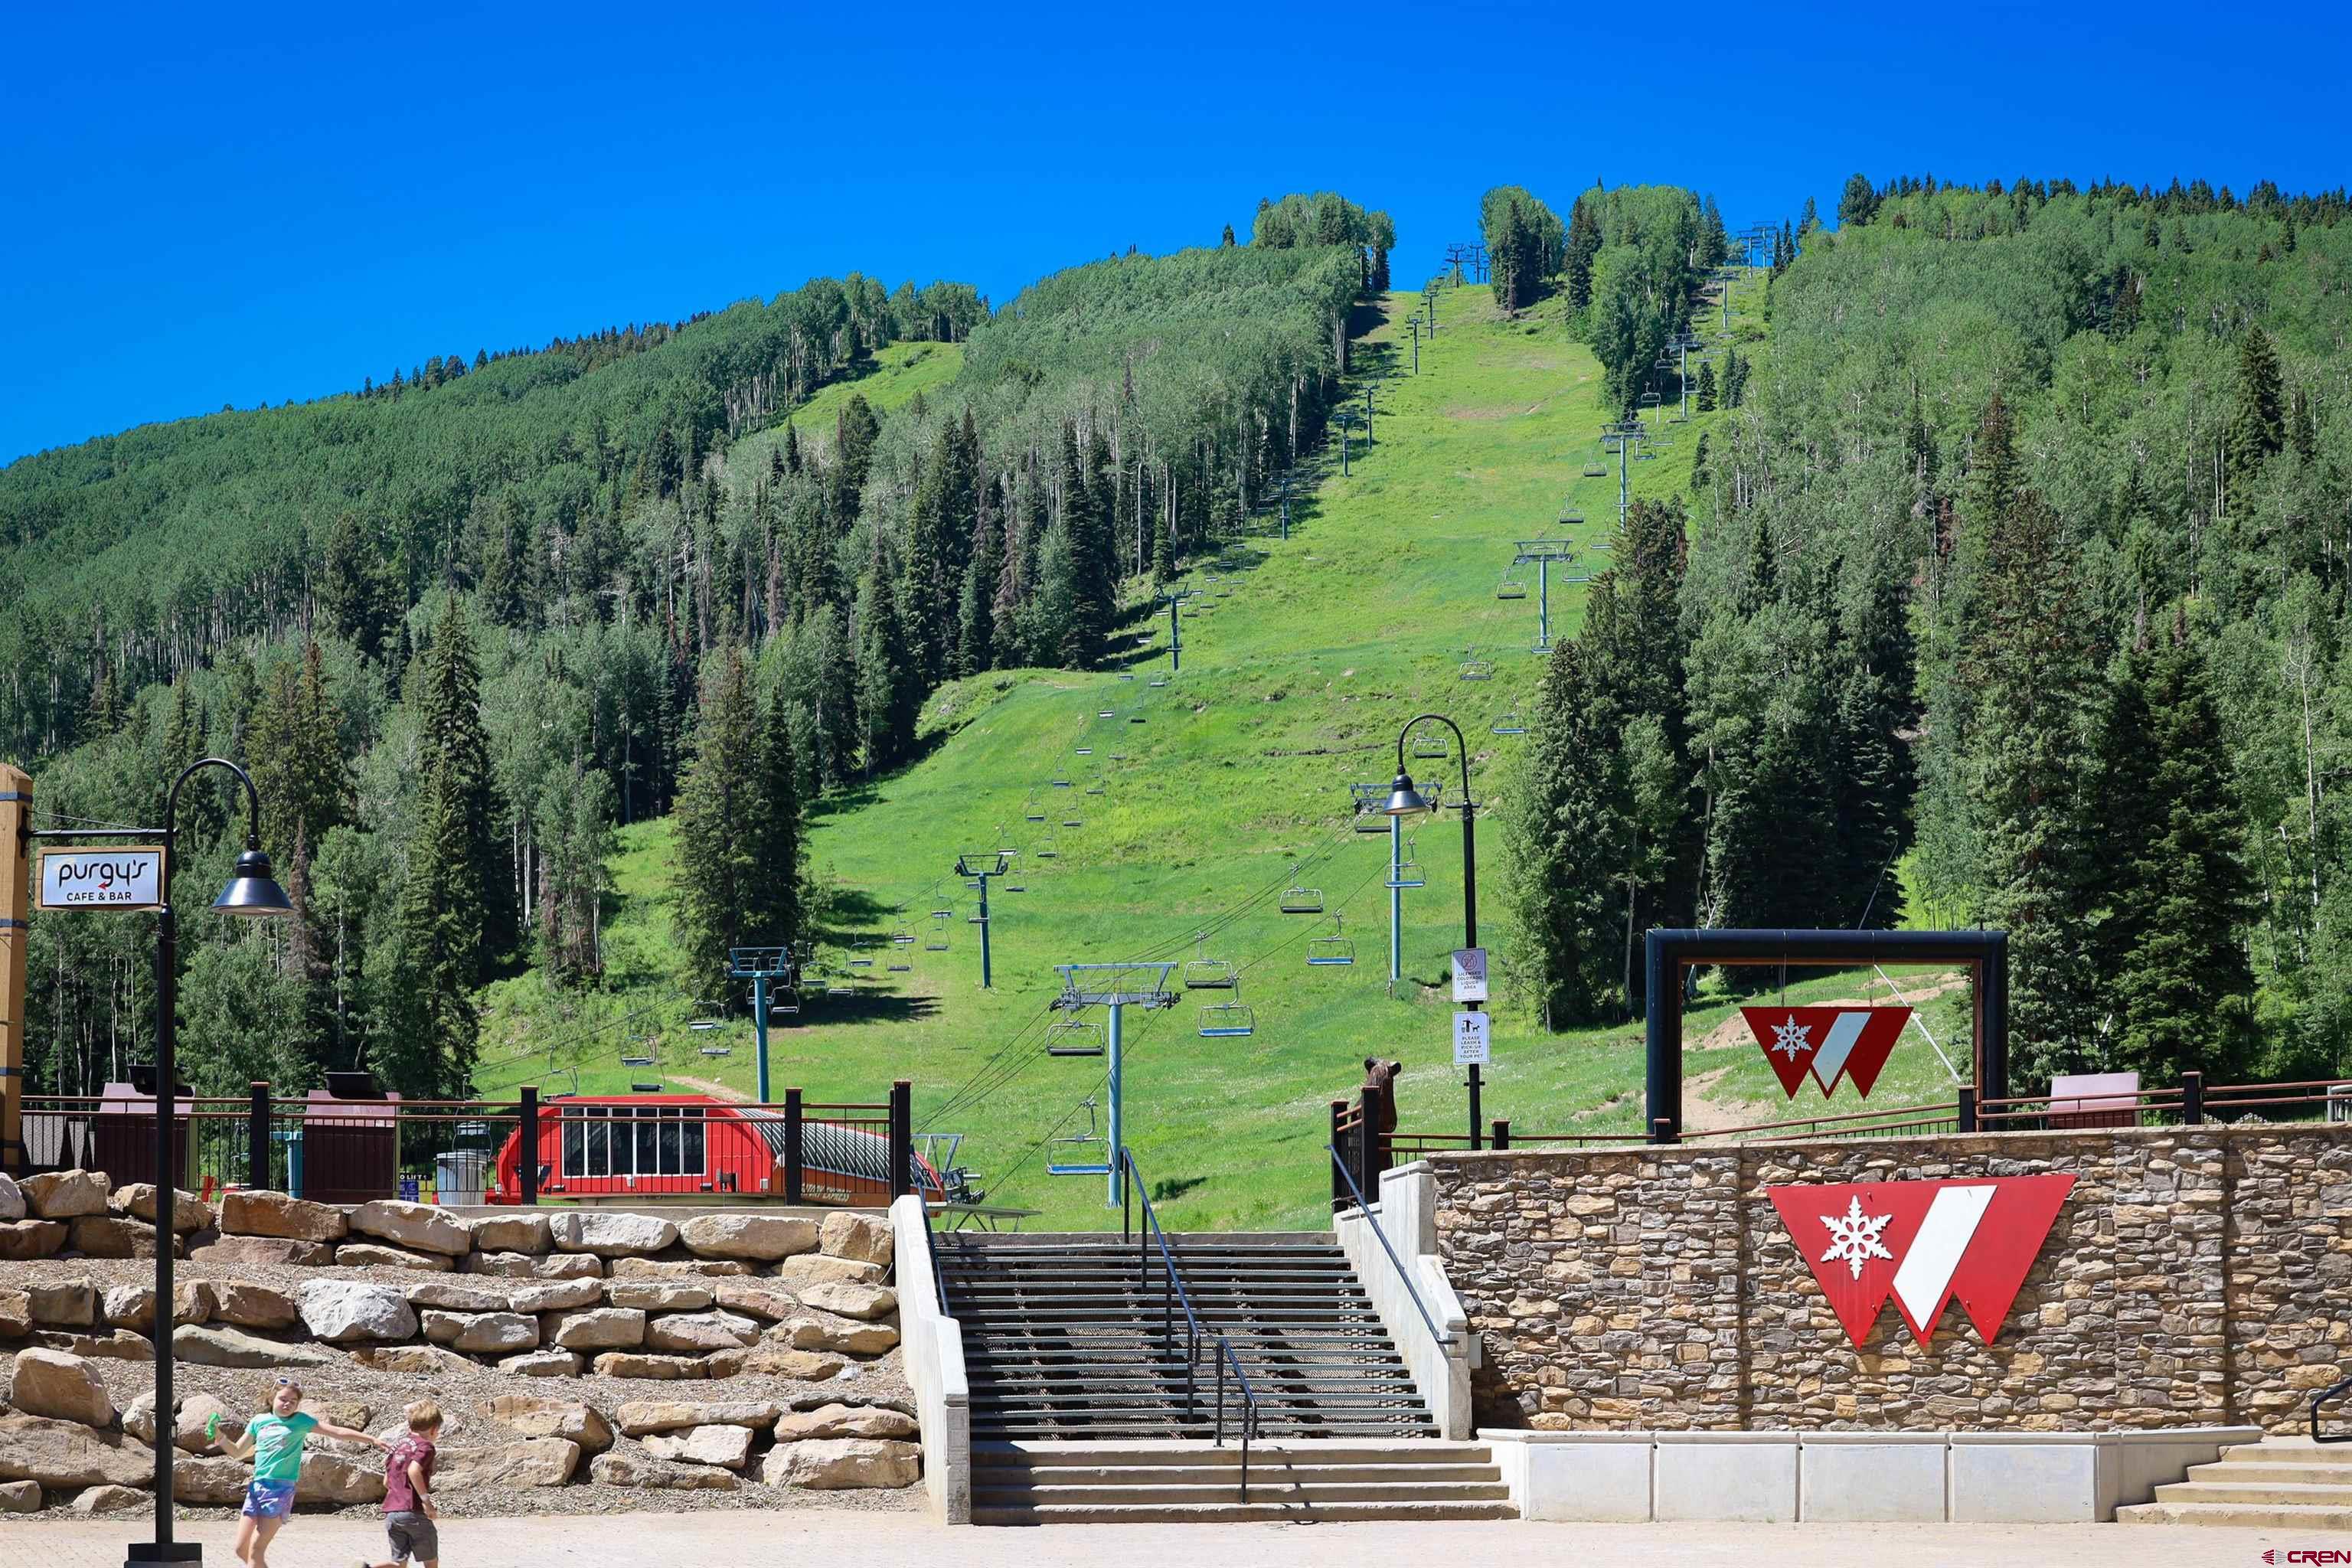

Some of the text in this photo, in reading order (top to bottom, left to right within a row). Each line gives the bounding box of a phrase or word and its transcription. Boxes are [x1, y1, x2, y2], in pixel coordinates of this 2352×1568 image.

[58, 859, 148, 890] purgy's
[67, 891, 132, 901] CAFE & BAR
